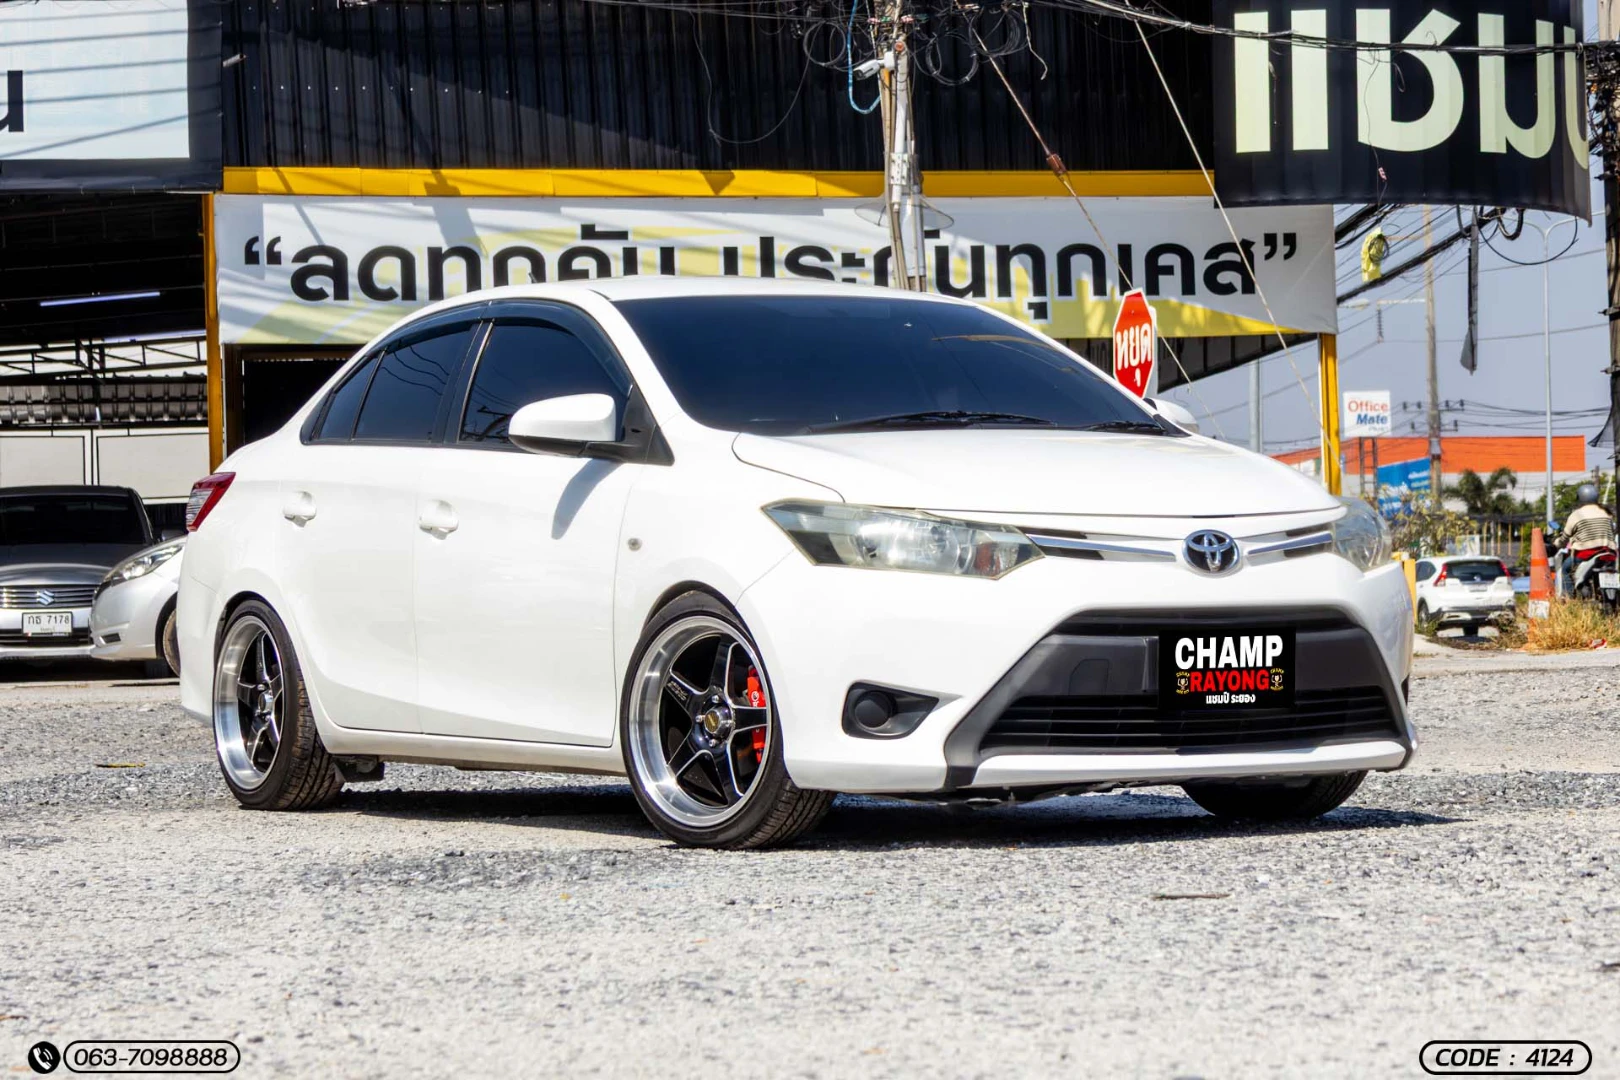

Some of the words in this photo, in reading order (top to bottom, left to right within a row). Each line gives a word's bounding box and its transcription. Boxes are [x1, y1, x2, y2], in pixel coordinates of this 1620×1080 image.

[1116, 322, 1152, 388] หยุด
[1348, 400, 1388, 412] Office
[1356, 413, 1388, 425] Mate
[47, 615, 69, 624] 7178
